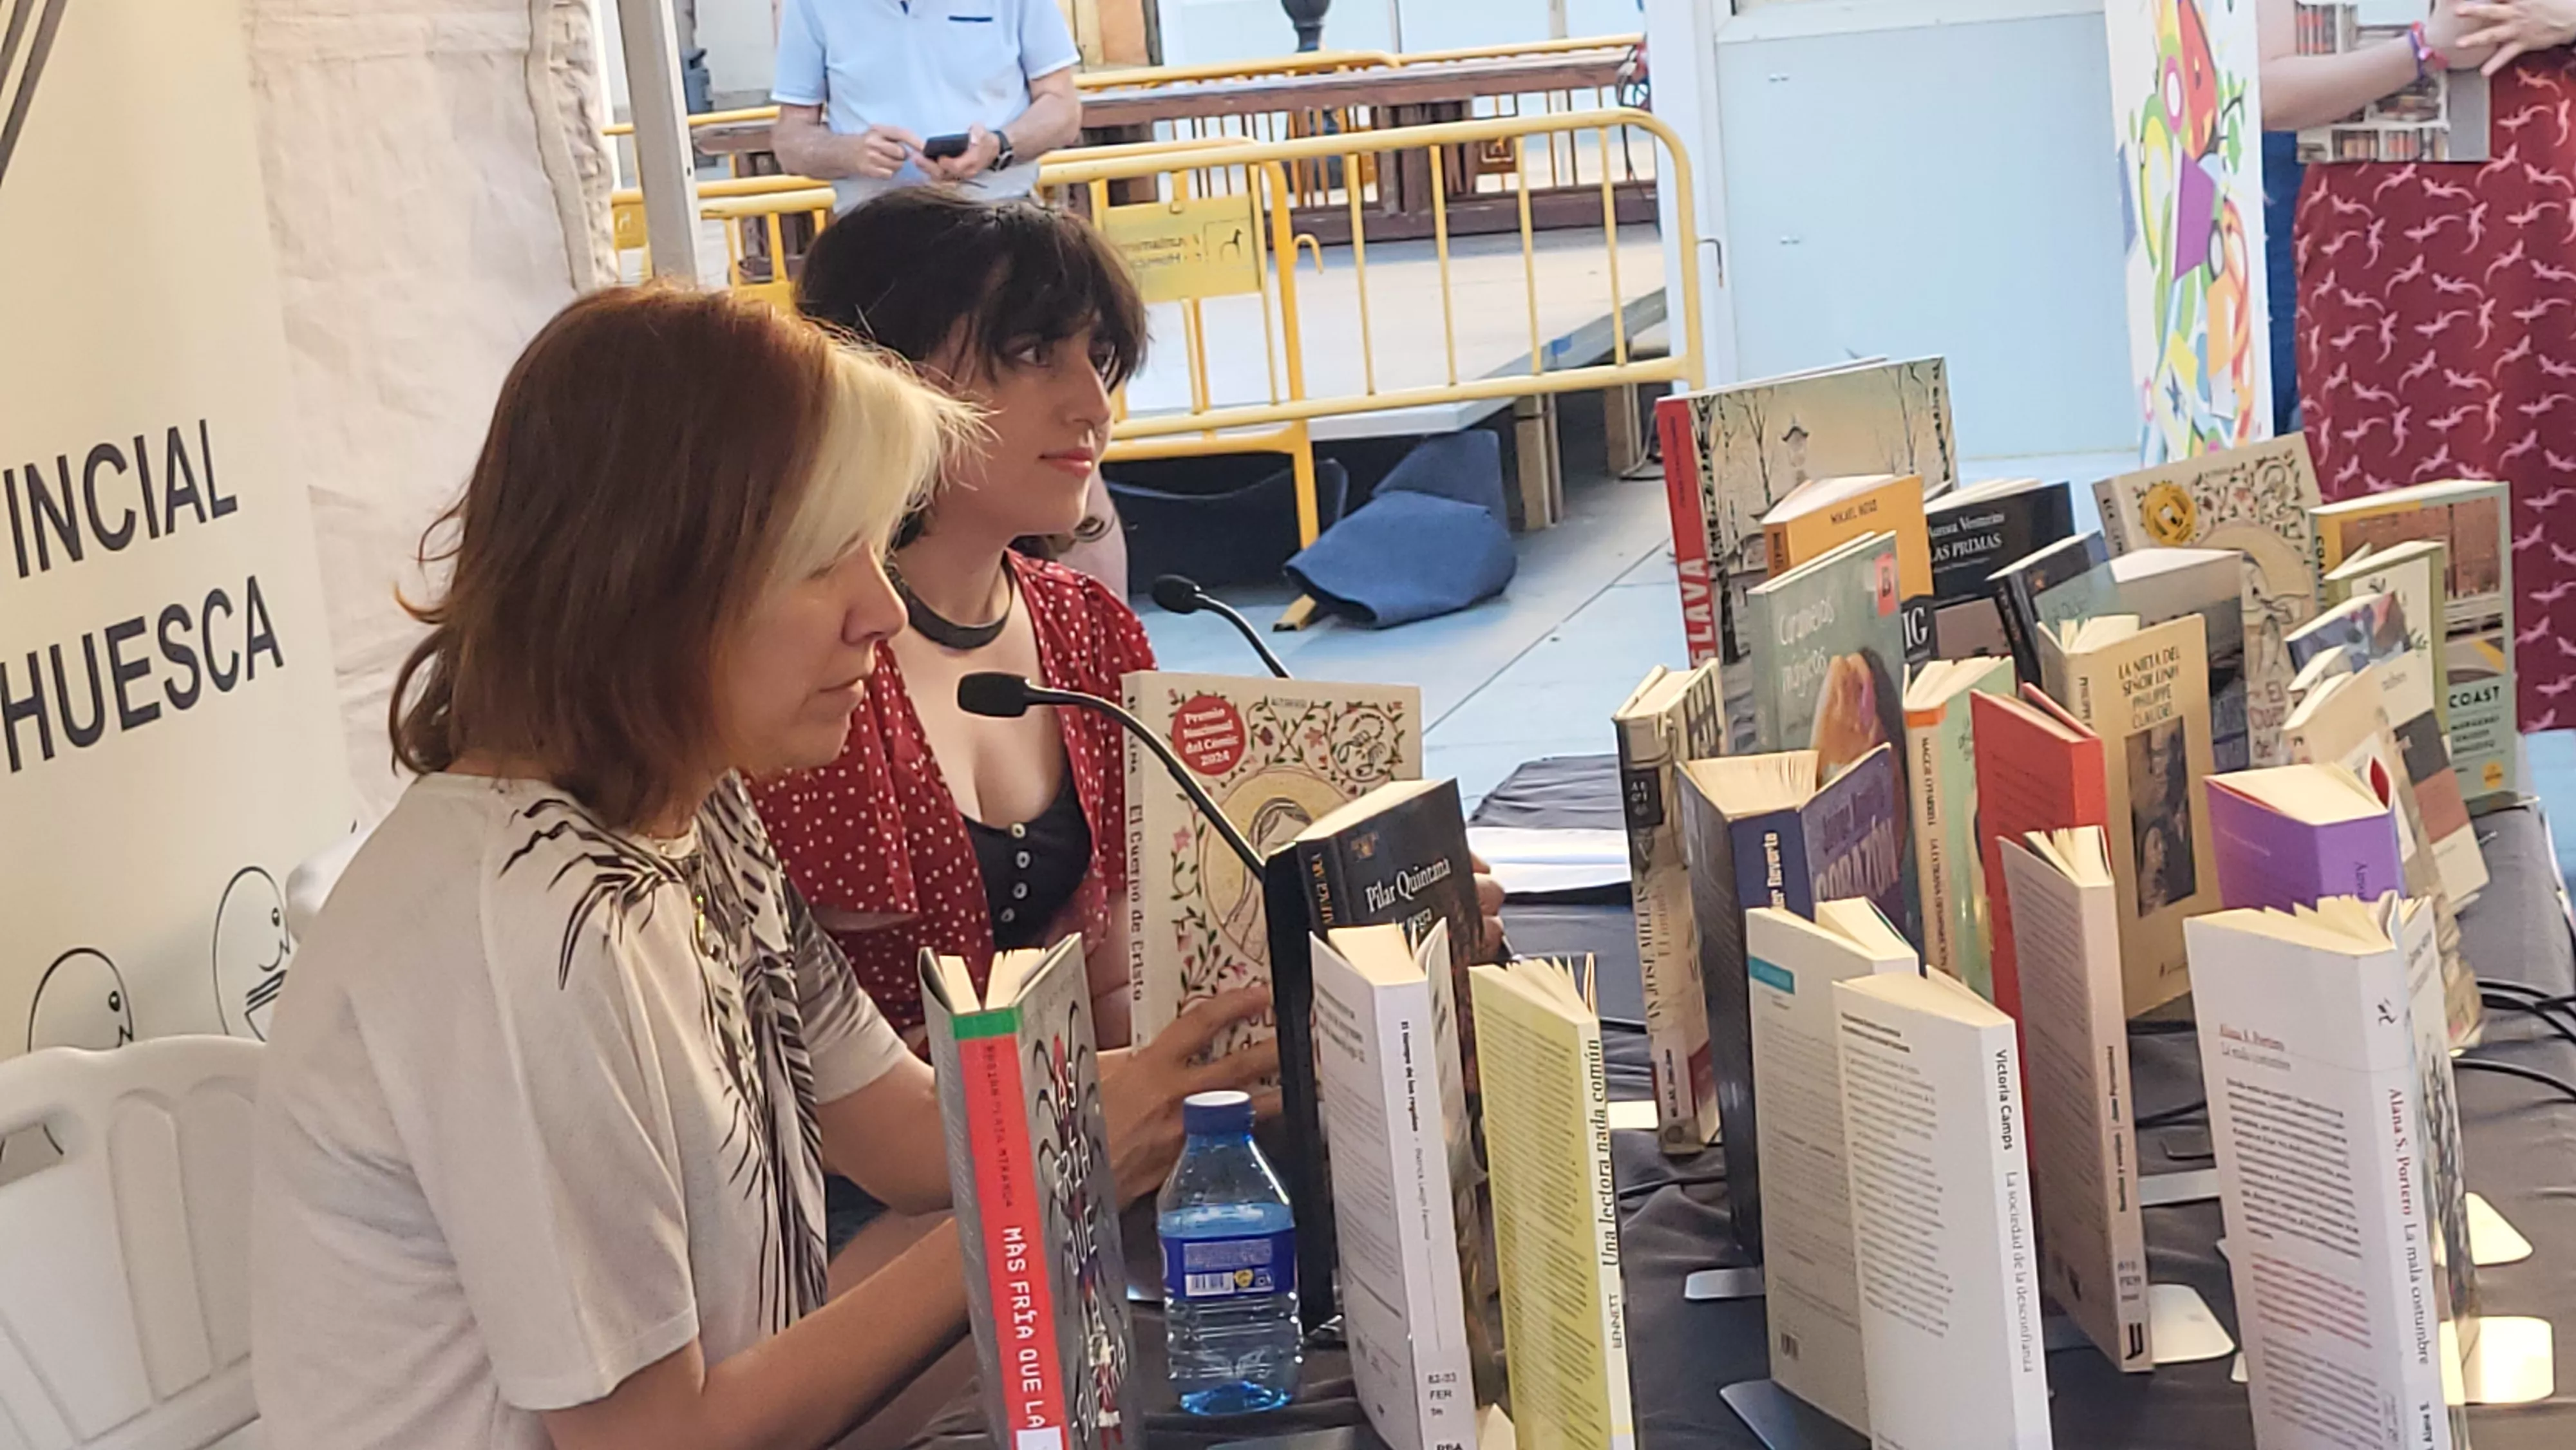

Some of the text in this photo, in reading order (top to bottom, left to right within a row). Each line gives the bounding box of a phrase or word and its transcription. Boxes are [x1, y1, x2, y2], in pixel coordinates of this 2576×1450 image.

[3, 419, 238, 578] INCIAL
[1953, 533, 2003, 558] PRIMAS
[0, 575, 284, 773] HUESCA
[2448, 685, 2499, 708] COAST
[1365, 879, 1397, 913] Pilar
[1396, 858, 1452, 901] Quintana
[1996, 1049, 2013, 1151] Victoria Camps
[1584, 1039, 1618, 1267] Una lectora nada común
[2388, 1088, 2404, 1135] Alana
[2396, 1156, 2412, 1216] Portero
[1009, 1281, 1037, 1342] FRÍA
[2403, 1223, 2431, 1364] La mala costumbre
[1015, 1348, 1042, 1393] QUE
[1023, 1400, 1046, 1430] LA
